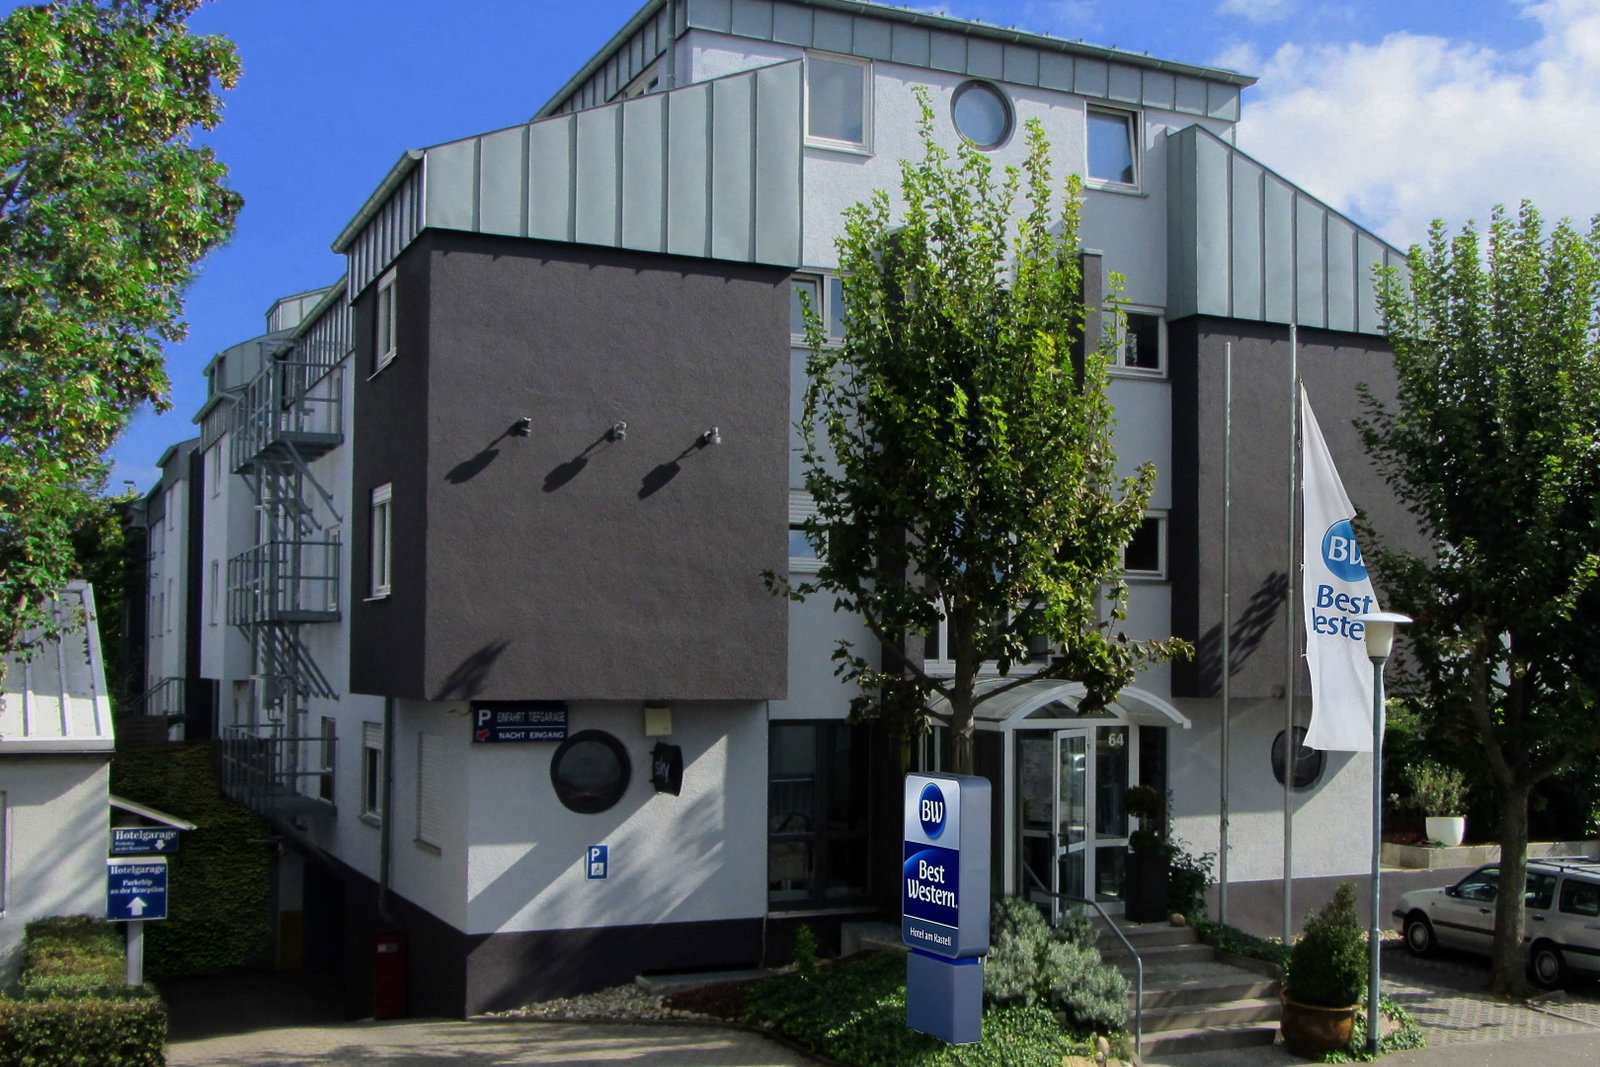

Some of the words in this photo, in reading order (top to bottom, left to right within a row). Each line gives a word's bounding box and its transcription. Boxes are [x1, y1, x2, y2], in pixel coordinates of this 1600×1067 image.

[1316, 584, 1373, 615] Best
[478, 709, 492, 727] P
[497, 711, 526, 723] EINFAHRT
[528, 711, 565, 723] TIEFGARAGE
[498, 731, 526, 740] NACHT
[529, 731, 564, 740] EINGANG
[1108, 733, 1125, 747] 64
[655, 755, 670, 784] sky
[921, 800, 944, 824] BW
[115, 830, 177, 842] Hotelgarage
[591, 848, 600, 862] P
[110, 866, 165, 876] Hotelgarage
[919, 859, 945, 884] Best
[910, 926, 925, 939] Hotel
[925, 932, 934, 940] am
[934, 933, 952, 947] Kastell
